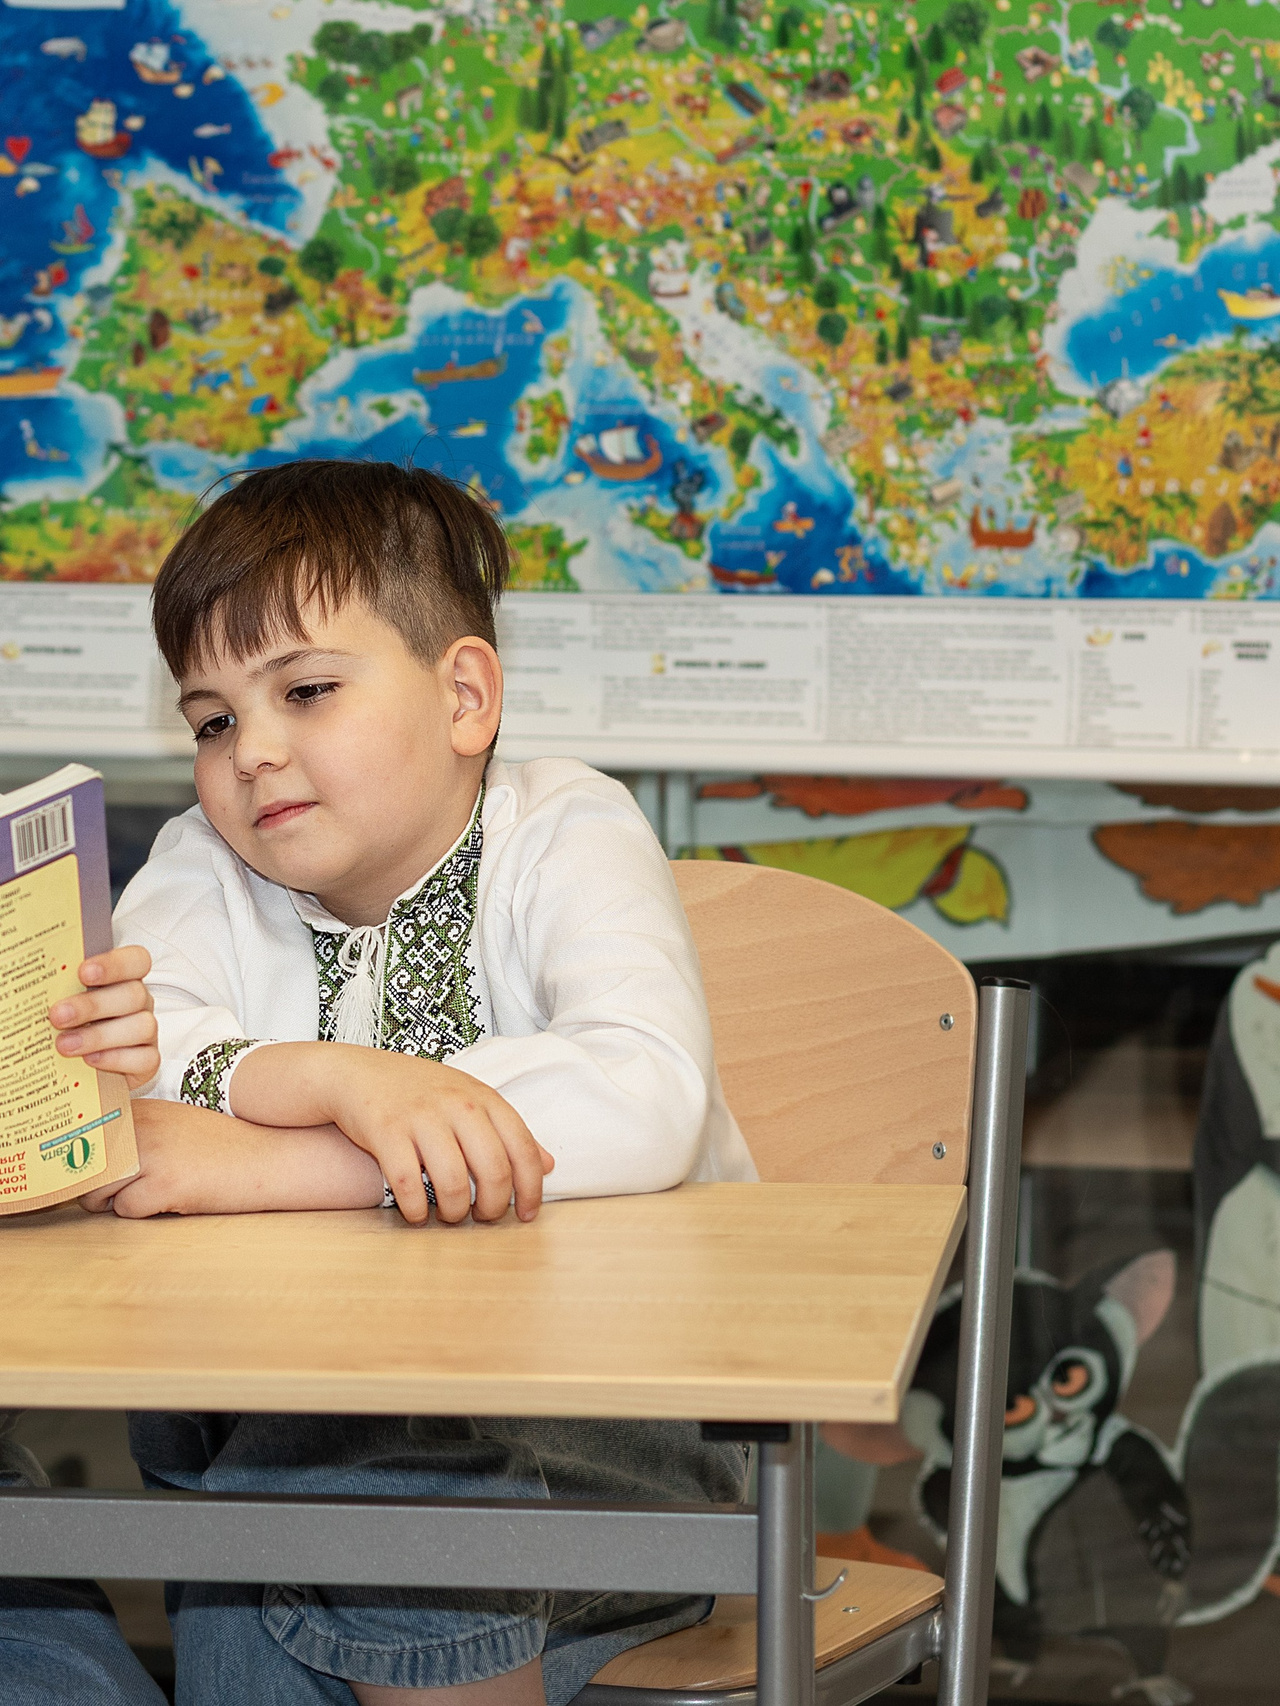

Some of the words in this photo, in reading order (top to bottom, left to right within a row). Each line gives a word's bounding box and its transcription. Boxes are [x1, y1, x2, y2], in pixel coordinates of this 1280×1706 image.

[17, 1085, 70, 1113] ПОСІБНИКИ
[14, 1118, 73, 1145] ЛІТЕРАТУРНЕ
[0, 1151, 26, 1165] ДЛЯ
[41, 1136, 90, 1170] ОСВІТА
[18, 1163, 26, 1171] З
